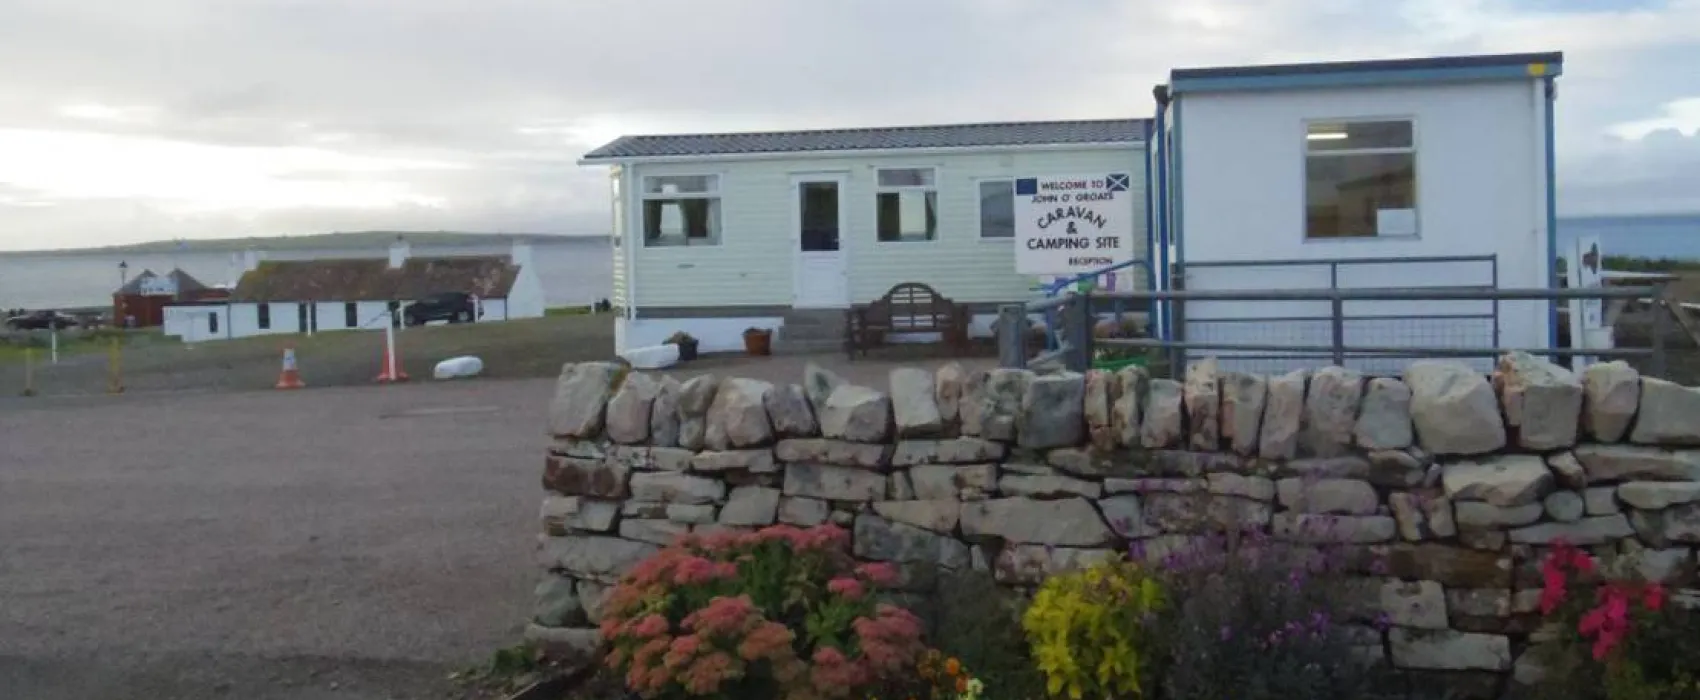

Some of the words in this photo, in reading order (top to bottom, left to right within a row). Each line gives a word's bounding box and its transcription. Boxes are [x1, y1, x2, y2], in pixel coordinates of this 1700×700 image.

[1041, 181, 1087, 190] WELCOME
[1091, 180, 1104, 188] TO
[1032, 195, 1057, 203] JOHN
[1037, 206, 1107, 229] CARAVAN
[1066, 221, 1078, 234] &
[1027, 237, 1090, 250] CAMPING
[1095, 236, 1120, 249] SITE
[1069, 257, 1113, 265] RECEPTION
